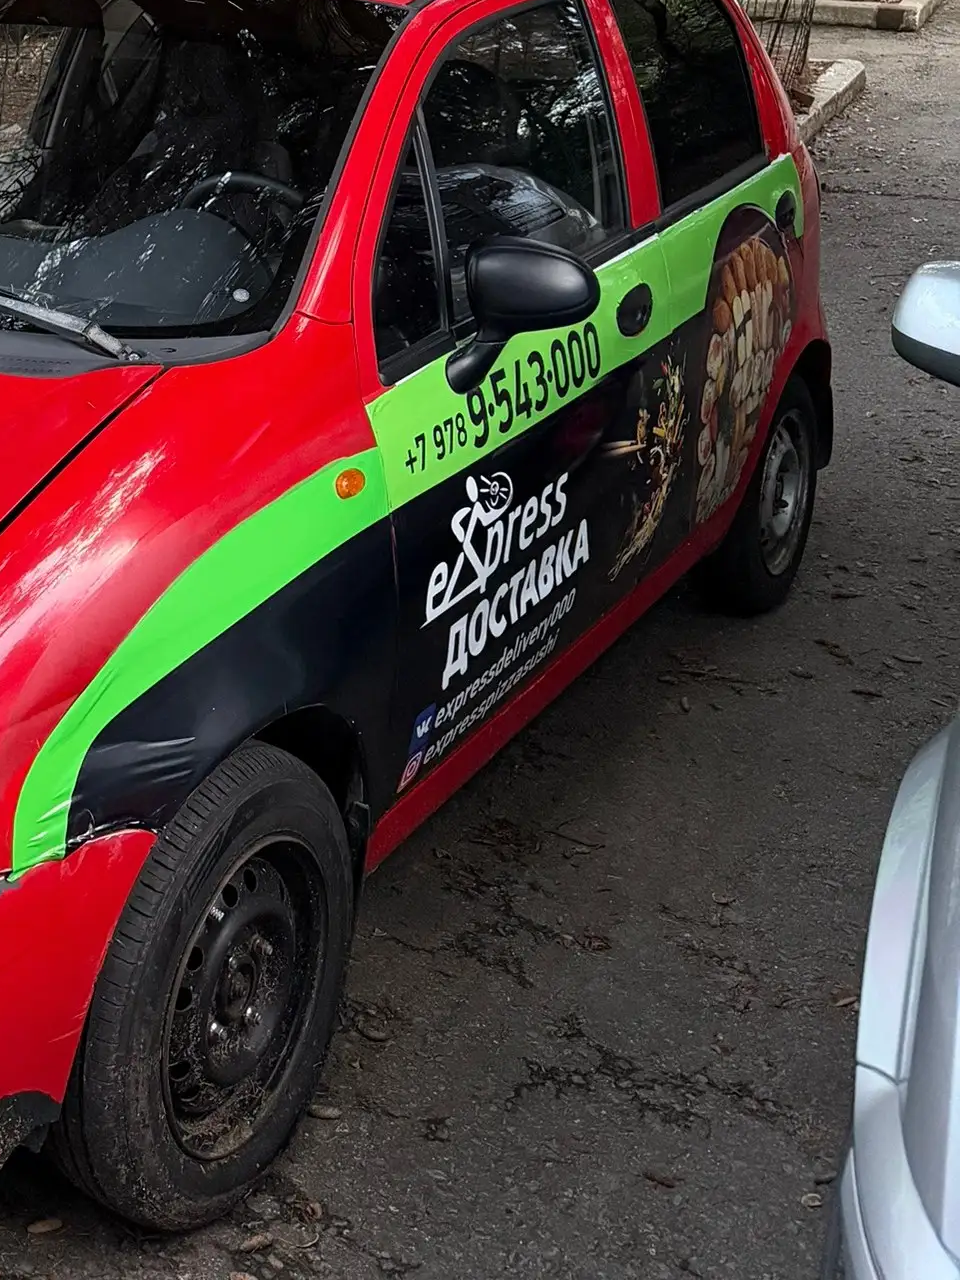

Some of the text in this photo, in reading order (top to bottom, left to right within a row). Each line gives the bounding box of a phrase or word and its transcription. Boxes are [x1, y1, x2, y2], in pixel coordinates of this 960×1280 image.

[405, 432, 426, 474] +7
[432, 412, 468, 461] 978
[442, 519, 590, 691] ДОСТАВКА
[423, 627, 561, 765] expresspizzasushi
